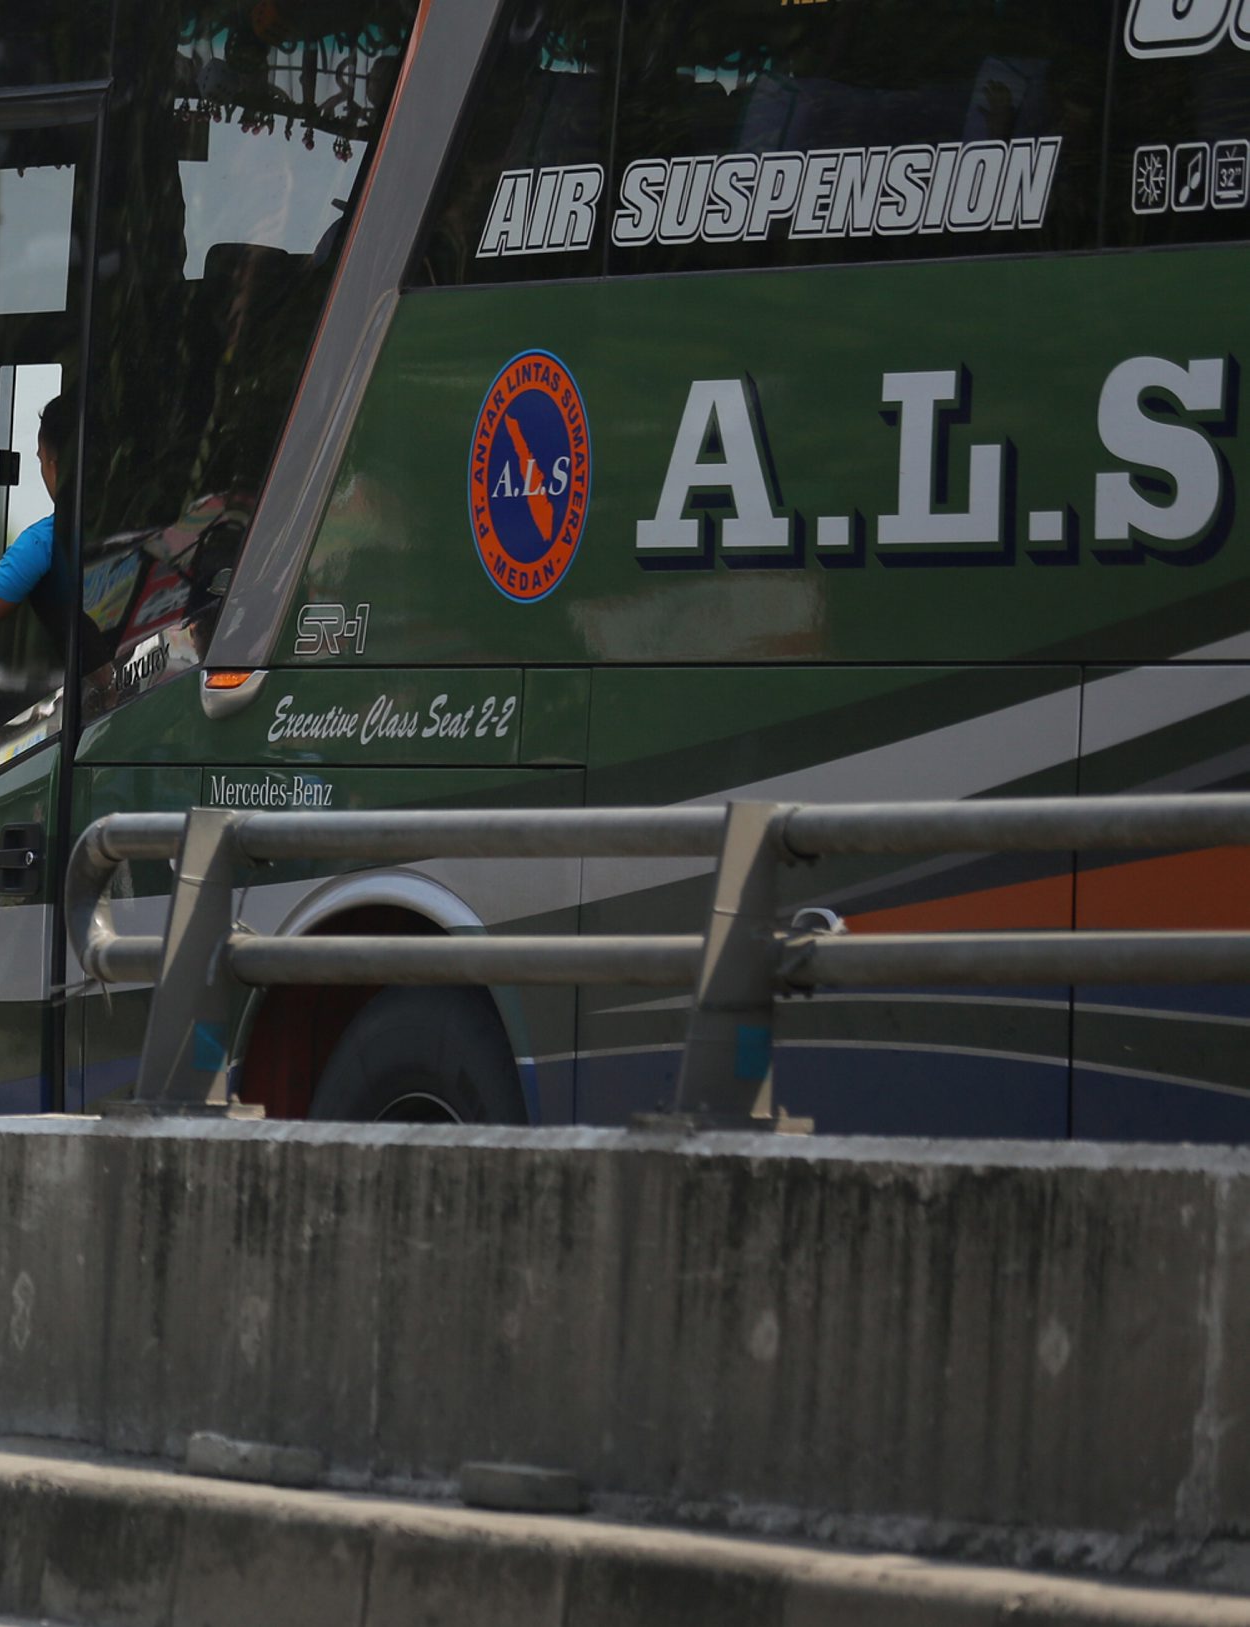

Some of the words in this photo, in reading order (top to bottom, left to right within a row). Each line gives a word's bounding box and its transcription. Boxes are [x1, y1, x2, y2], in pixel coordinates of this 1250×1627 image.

[476, 164, 604, 258] AIR
[611, 136, 1062, 248] SUSPENSION
[474, 389, 506, 486] ANTAR
[506, 362, 561, 394] LINTAS
[560, 388, 585, 546] SUMATERA
[491, 456, 571, 498] A.L.S
[636, 356, 1226, 551] A.L.S
[294, 603, 371, 655] SR-1
[268, 695, 359, 742] Executive
[360, 694, 419, 745] Class
[421, 693, 475, 739] Seat
[475, 696, 517, 738] 2-2
[210, 775, 333, 807] Mercedes-Benz
